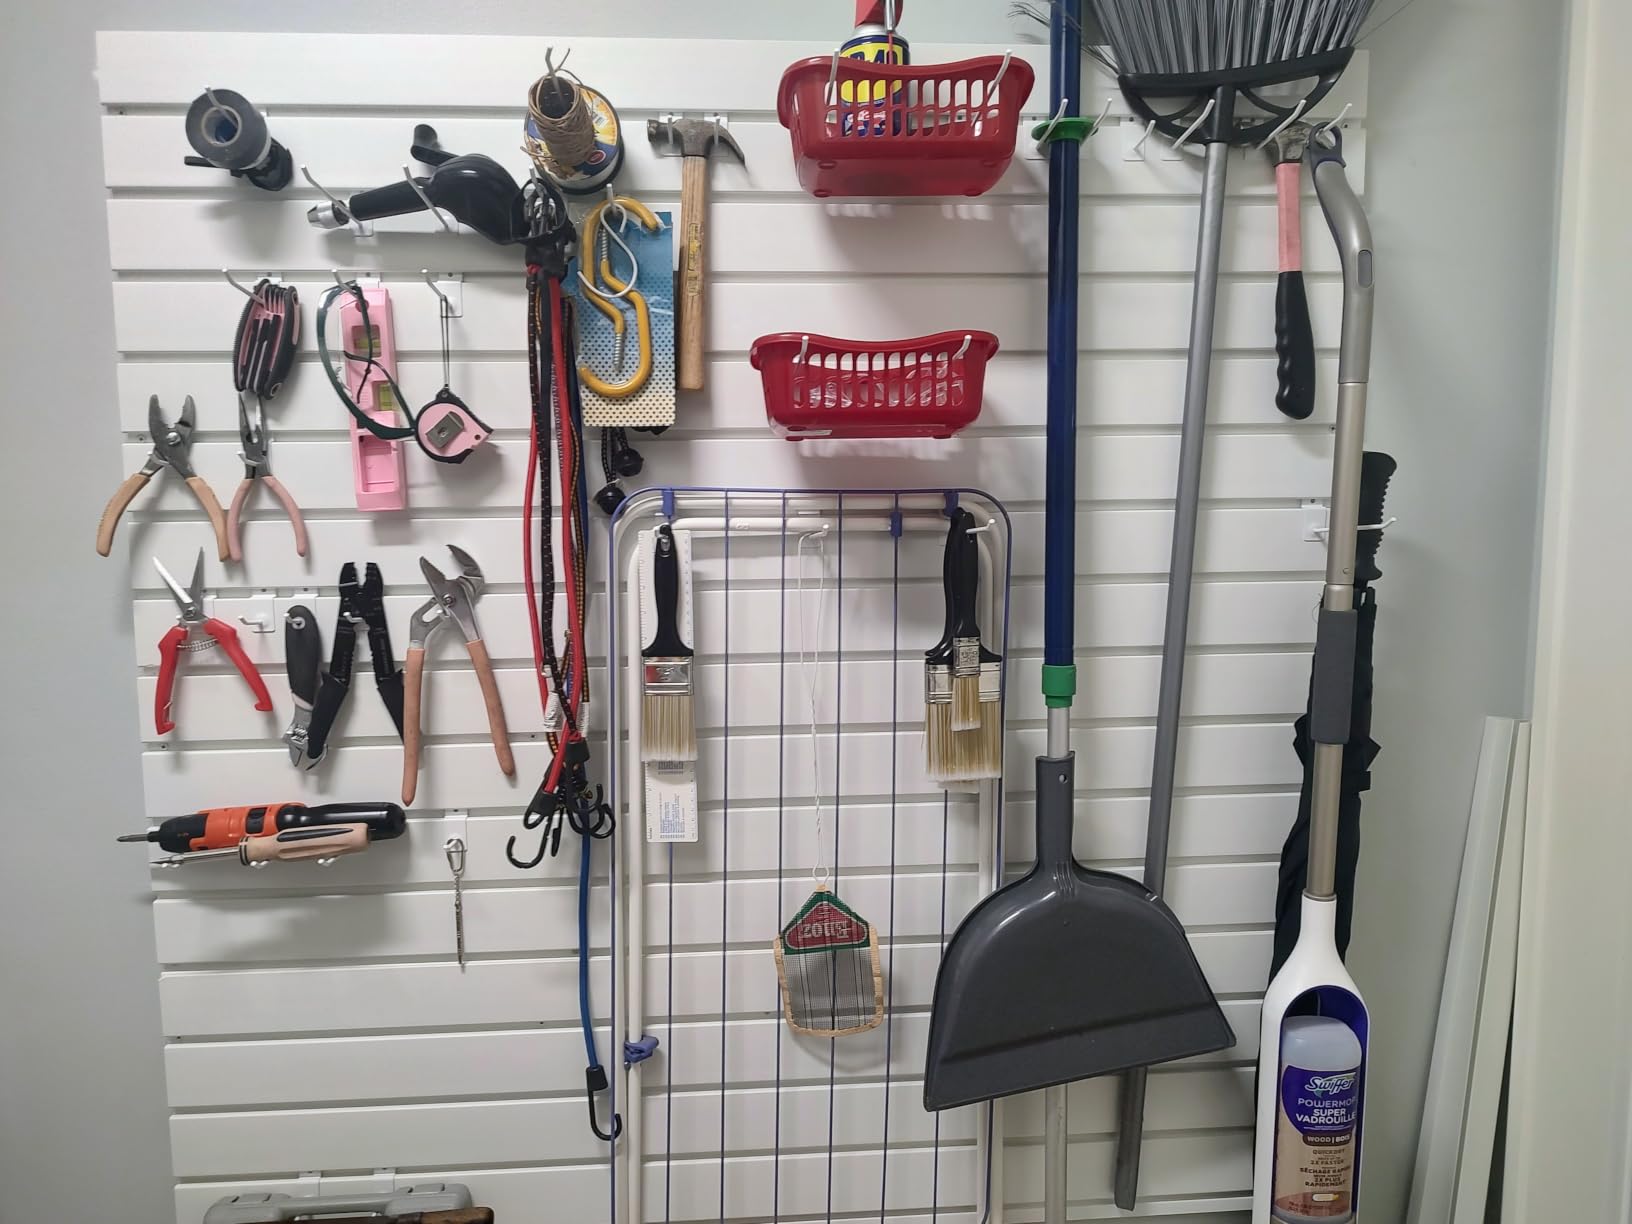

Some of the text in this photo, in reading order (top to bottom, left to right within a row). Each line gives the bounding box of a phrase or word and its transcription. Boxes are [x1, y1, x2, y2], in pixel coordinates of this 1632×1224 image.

[1305, 1075, 1354, 1095] Swiffer
[1295, 1112, 1356, 1124] VADROUILLE
[1313, 1108, 1346, 1116] SUPER
